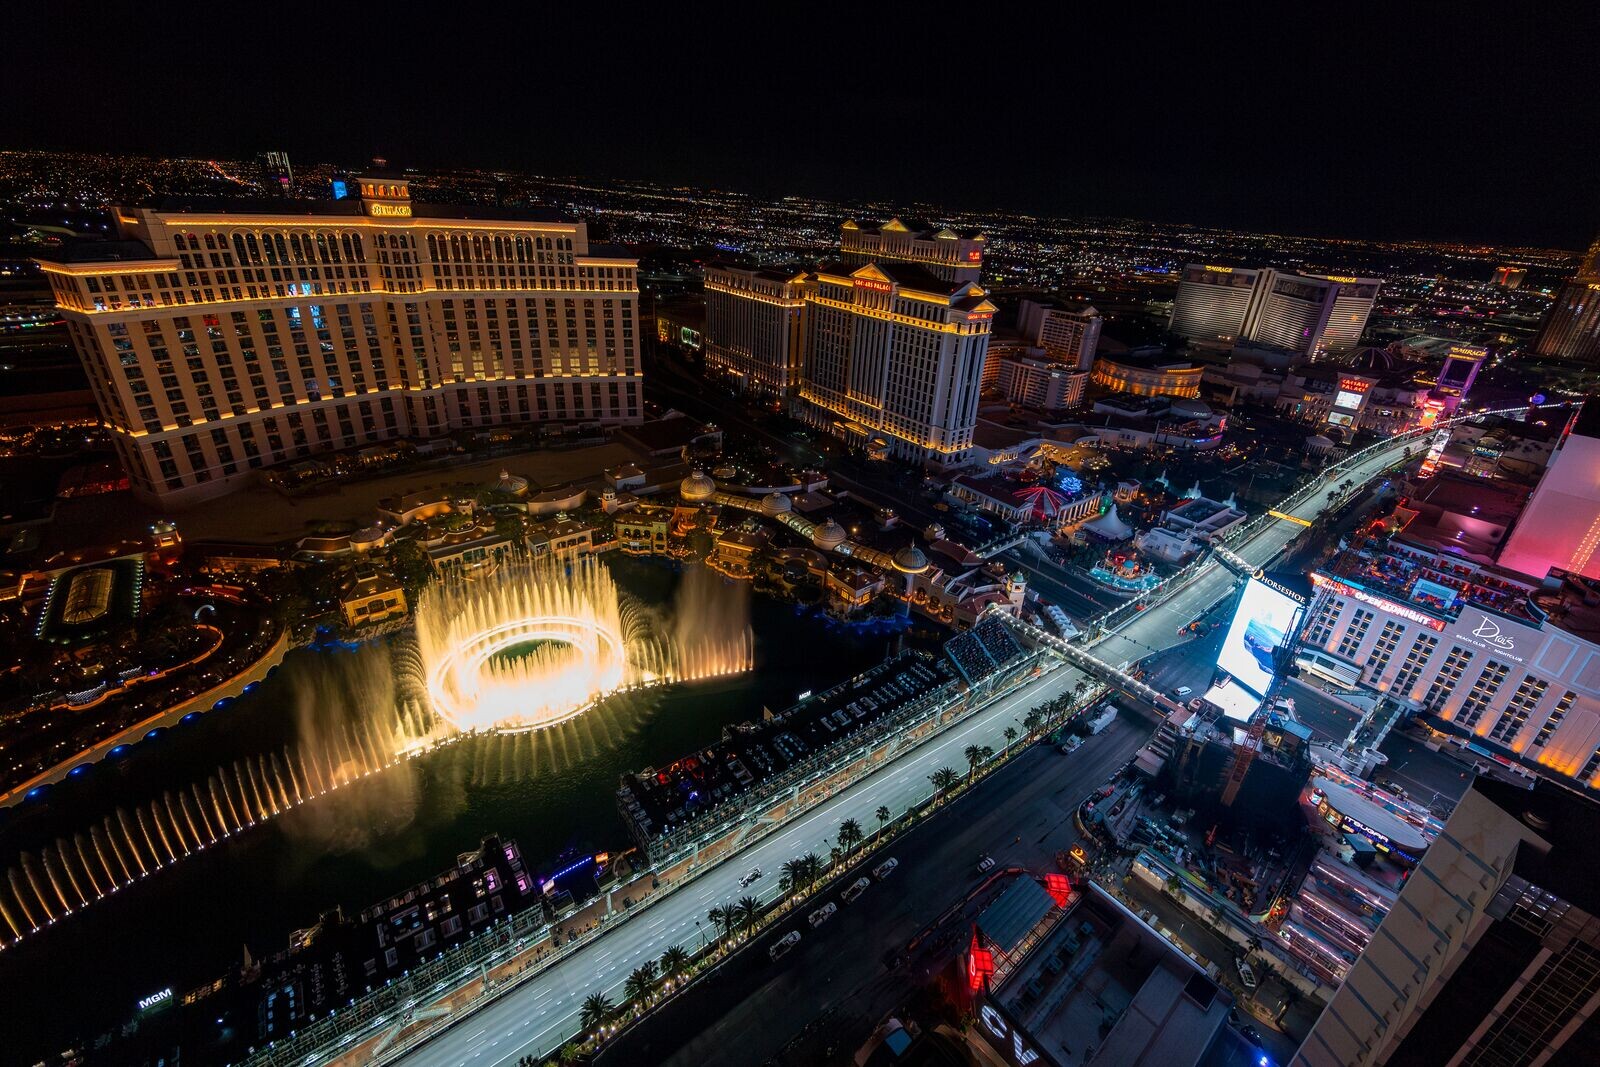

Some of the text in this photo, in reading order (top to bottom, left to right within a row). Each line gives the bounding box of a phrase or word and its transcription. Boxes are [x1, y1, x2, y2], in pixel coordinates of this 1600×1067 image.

[873, 282, 891, 292] PALACE
[1453, 347, 1487, 357] MIRAGE
[1341, 384, 1366, 392] PALACE
[1342, 379, 1369, 389] CAESARS
[1261, 576, 1306, 604] HORSESHOE
[1355, 591, 1431, 625] OPEN TONIGHT
[1456, 634, 1523, 662] BEACH CLUB NIGHTCLUB
[1344, 815, 1389, 843] ITSUGAR
[1397, 850, 1416, 862] WANT
[139, 988, 172, 1008] MGM
